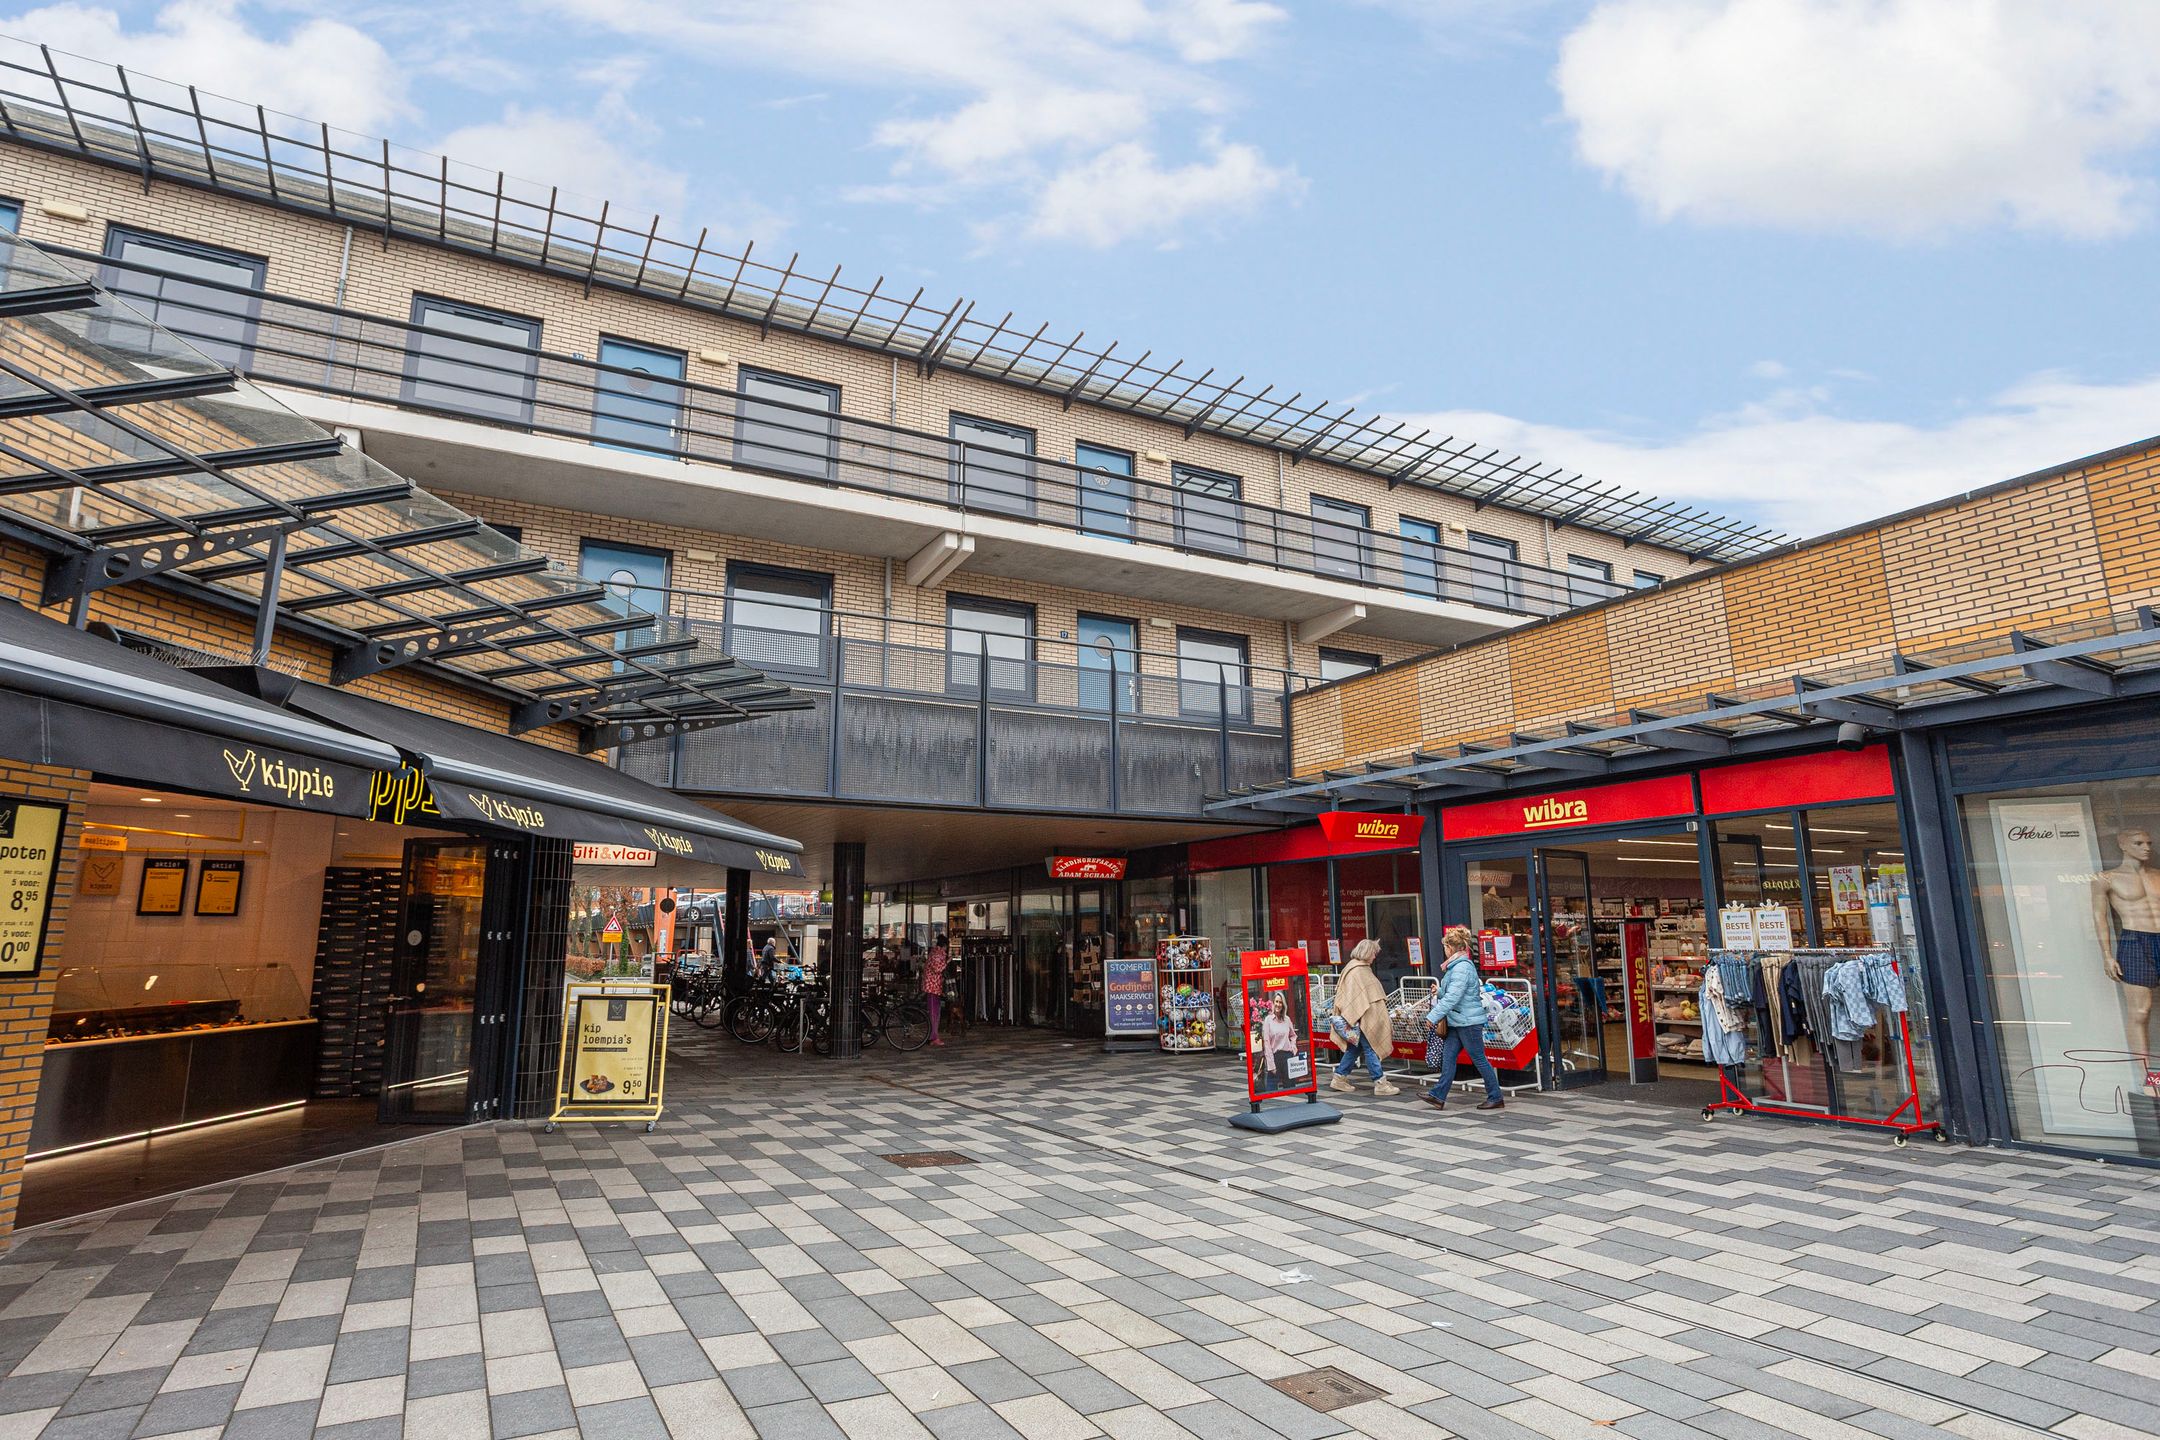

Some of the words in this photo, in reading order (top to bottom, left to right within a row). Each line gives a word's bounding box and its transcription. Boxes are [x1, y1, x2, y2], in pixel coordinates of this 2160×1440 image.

[261, 758, 334, 800] kippie
[493, 800, 545, 828] kippie
[1523, 798, 1588, 822] wibra
[1356, 820, 1400, 836] wibra
[659, 832, 693, 854] kippie
[766, 853, 791, 872] kippie
[1725, 922, 1750, 930] BESTE
[1760, 921, 1785, 929] BESTE
[3, 930, 8, 938] 5
[1260, 953, 1290, 966] wibra
[1110, 963, 1152, 971] STOMERIJ
[1109, 982, 1154, 992] Gordijnen
[1266, 978, 1286, 986] wibra
[1634, 957, 1649, 1024] wibra
[584, 1024, 601, 1034] kip
[583, 1034, 632, 1045] loempia's
